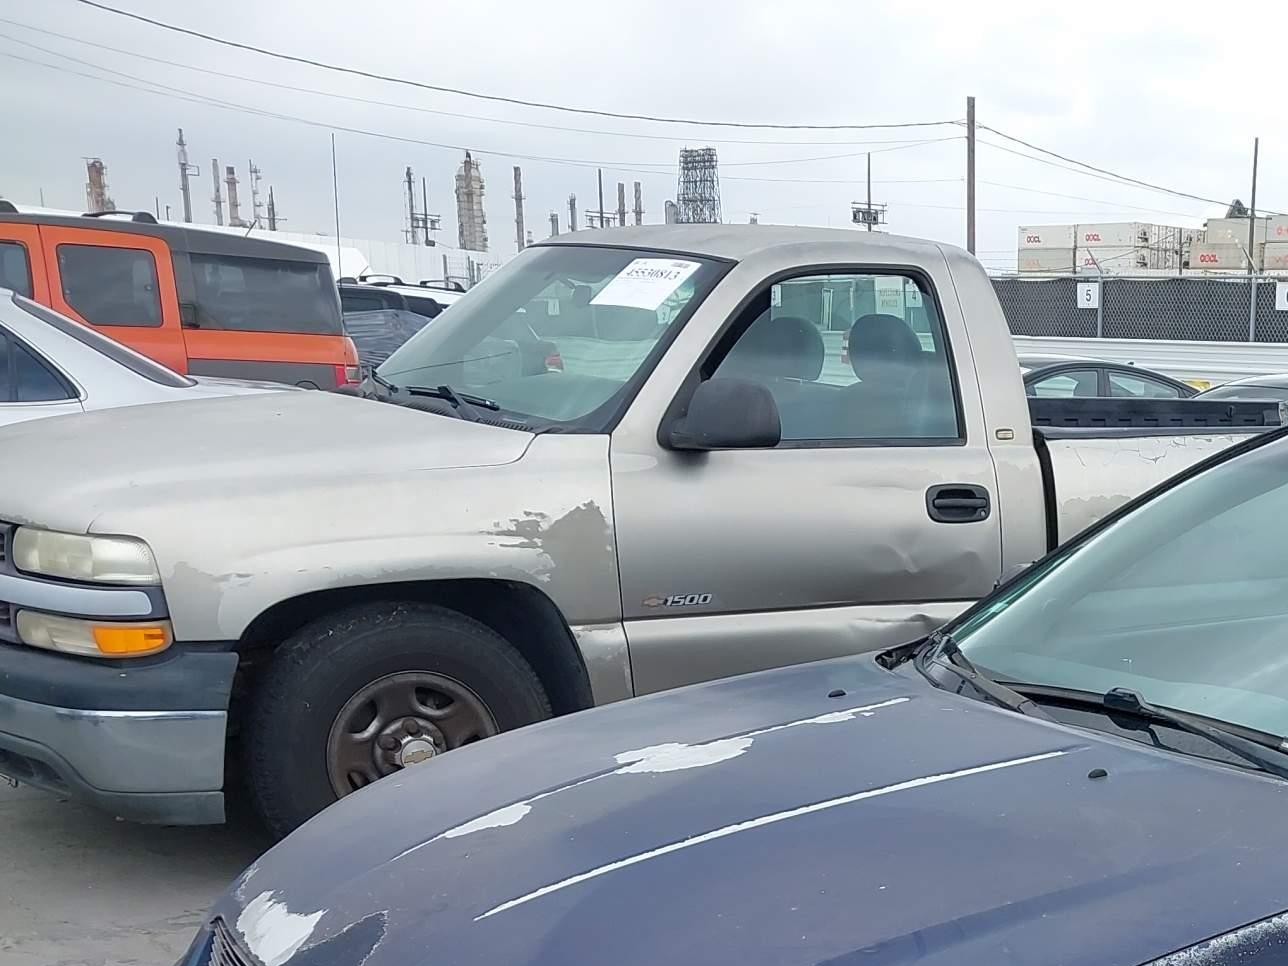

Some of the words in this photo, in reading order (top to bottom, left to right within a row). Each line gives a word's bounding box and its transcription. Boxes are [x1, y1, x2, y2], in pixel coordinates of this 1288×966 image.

[1026, 235, 1041, 244] OOCL
[1200, 254, 1218, 263] OOCL
[1085, 289, 1092, 302] 5
[665, 593, 713, 606] 1500
